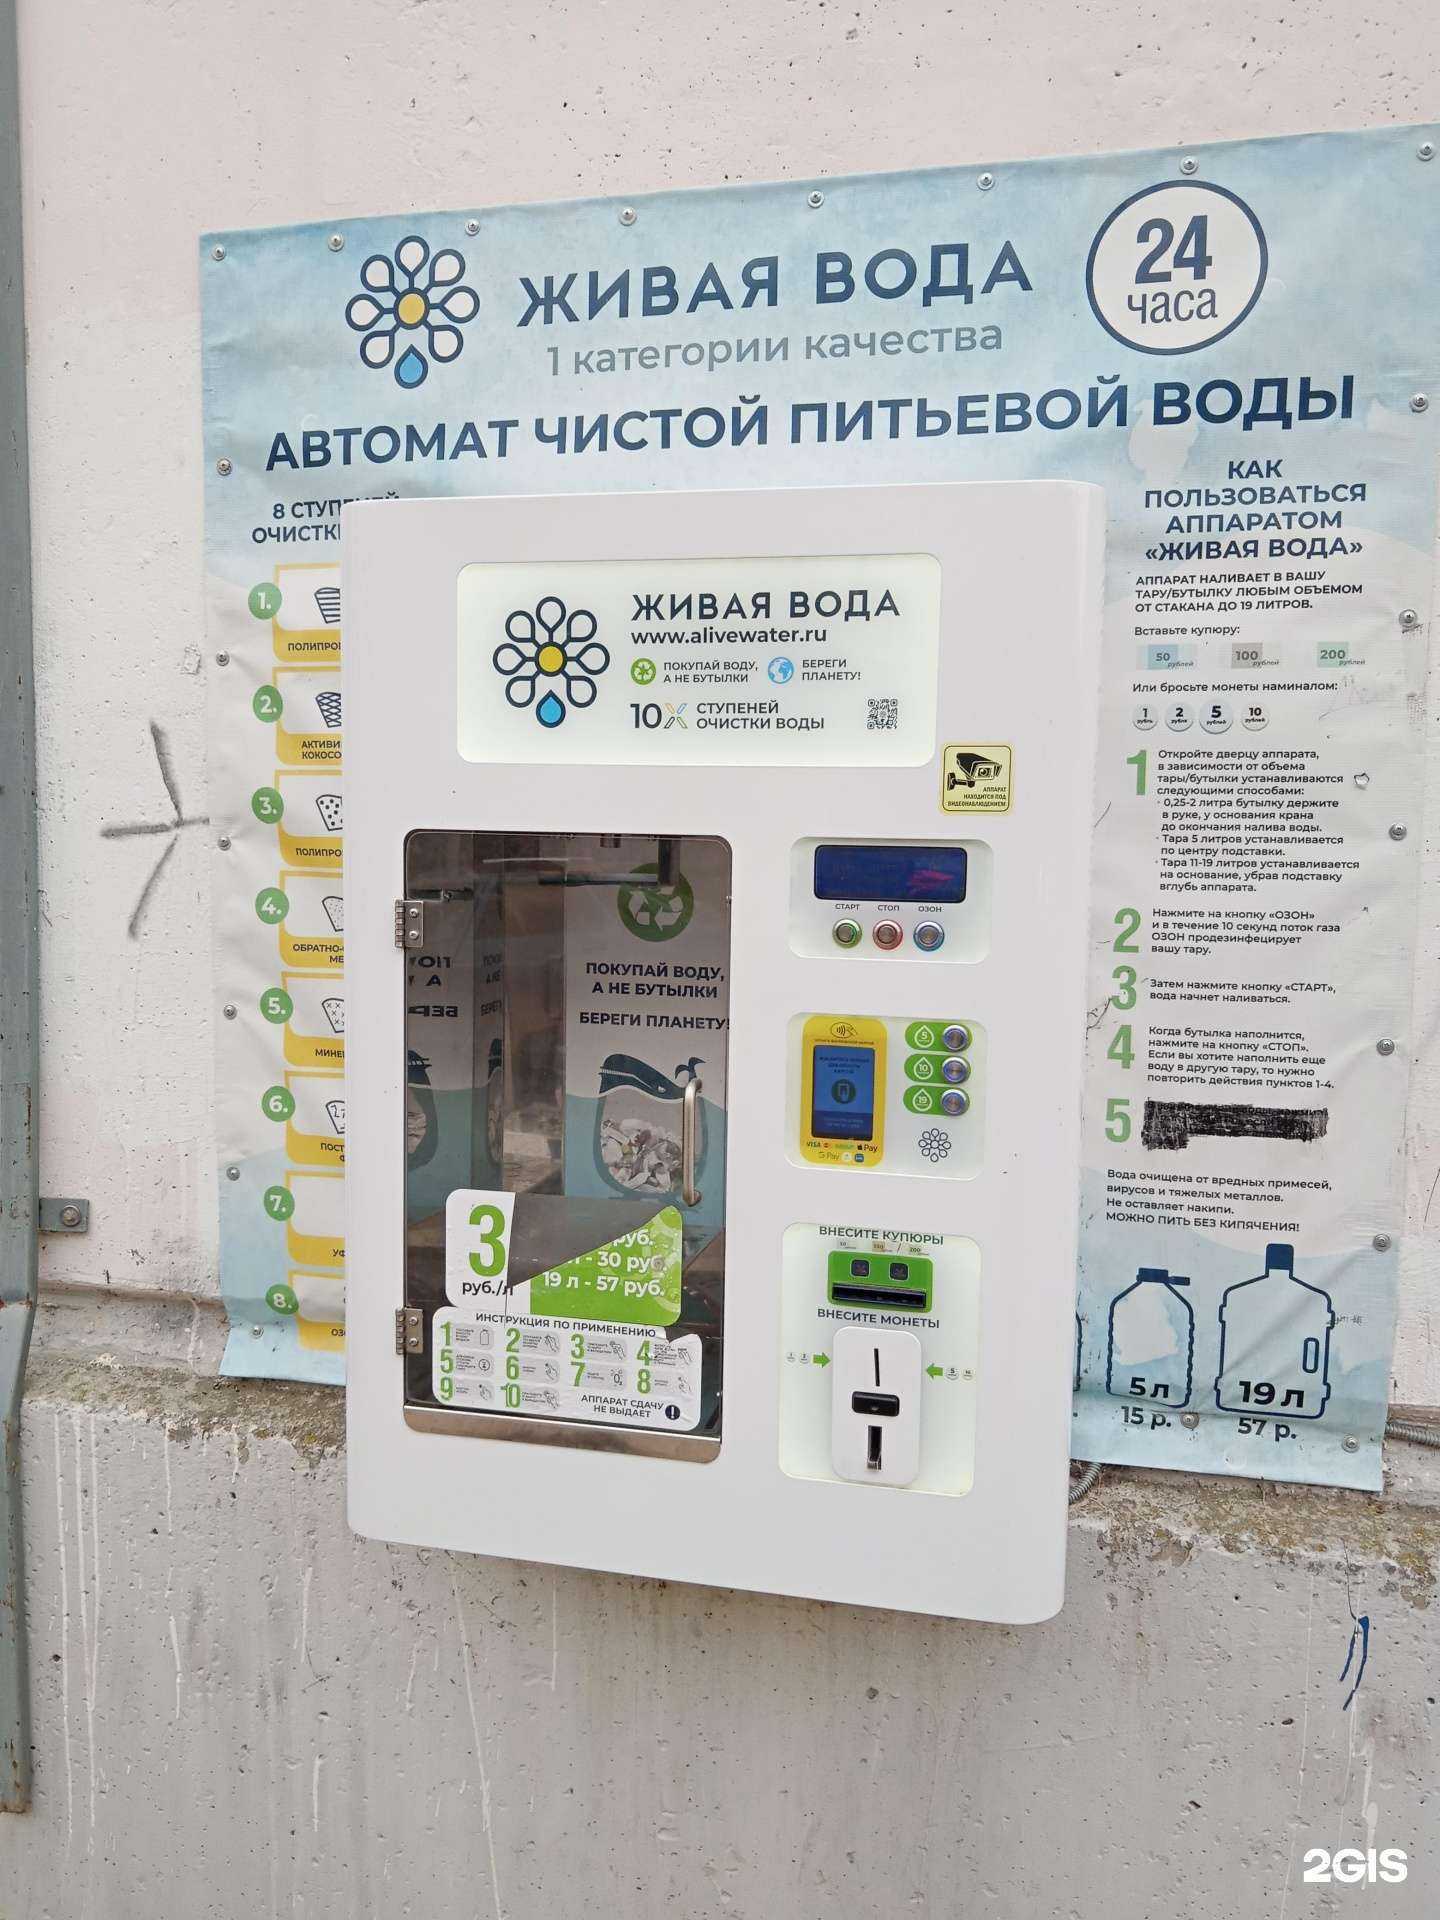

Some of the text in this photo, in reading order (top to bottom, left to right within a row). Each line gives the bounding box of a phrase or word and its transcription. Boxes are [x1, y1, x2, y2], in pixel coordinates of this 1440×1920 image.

[1135, 215, 1212, 284] 24
[517, 241, 1033, 327] ЖИВАЯ ВОДА
[1128, 289, 1218, 324] часа
[547, 325, 1001, 376] 1 категории качества
[265, 374, 1353, 472] АВТОМАТ ЧИСТОЙ ПИТЬЕВОЙ ВОДЫ
[1229, 459, 1283, 479] КАК
[1145, 483, 1366, 508] ПОЛЬЗОВАТЬСЯ
[273, 503, 285, 519] 8
[1165, 511, 1341, 534] АППАРАТОМ
[1146, 538, 1362, 560] «ЖИВАЯ ВОДА»
[1135, 570, 1326, 586] АППАРАТ НАЛИВАЕТ В ВАШУ
[258, 592, 271, 610] 1.
[1135, 584, 1363, 600] ТАРУ/БУТЫЛКУ ЛЮБЫМ ОБЪЕМОМ
[632, 590, 900, 621] ЖИВАЯ ВОДА
[1134, 599, 1313, 613] ОТ СТАКАНА ДО 19 ЛИТРОВ.
[631, 626, 826, 644] www.alivewater.ru
[1134, 626, 1240, 637] Вставьте купюру:
[802, 658, 847, 669] БЕРЕГИ
[1154, 651, 1172, 663] 50
[1235, 649, 1259, 662] 100
[1319, 648, 1347, 661] 200
[663, 659, 758, 672] ПОКУПАЙ ВОДУ,
[663, 673, 749, 683] А НЕ БУТЫЛКИ
[801, 671, 861, 681] ПЛАНЕТУ!
[1132, 681, 1338, 694] Или бросьте монеты наминалом:
[260, 695, 277, 713] 2.
[697, 700, 778, 714] СТУПЕНЕЙ
[1142, 707, 1149, 718] 1
[1174, 706, 1185, 718] 2
[1211, 705, 1222, 718] 5
[1248, 706, 1263, 718] 10
[696, 717, 824, 731] ОЧИСТКИ ВОДЫ
[1158, 749, 1320, 761] Откройте дверцу аппарата,
[1126, 749, 1147, 795] 1
[259, 797, 277, 815] 3.
[261, 897, 282, 915] 4.
[1152, 908, 1315, 922] Нажмите на кнопку «ОЗОН»
[1113, 907, 1142, 953] 2
[585, 962, 725, 981] ПОКУПАЙ ВОДУ,
[592, 982, 718, 998] А НЕ БУТЫЛКИ
[1110, 965, 1138, 1010] 3
[1150, 978, 1336, 994] Затем нажмите кнопку «СТАРТ»,
[268, 997, 286, 1015] 5.
[1149, 992, 1291, 1004] вода начнет наливаться.
[580, 1012, 641, 1027] БЕРЕГИ
[1107, 1024, 1135, 1069] 4
[269, 1095, 288, 1113] 6.
[1104, 1098, 1132, 1143] 5
[805, 1140, 822, 1149] VISA
[863, 1143, 879, 1153] Pay
[1107, 1168, 1332, 1191] Вода очищена от вредных примесей,
[1106, 1184, 1284, 1202] вирусов и тяжелых металлов.
[270, 1195, 286, 1212] 7.
[1106, 1197, 1235, 1215] Не оставляет накипи.
[1106, 1211, 1300, 1232] МОЖНО ПИТЬ БЕЗ КИПЯЧЕНИЯ!
[469, 1204, 506, 1277] 3
[819, 1226, 944, 1245] ВНЕСИТЕ КУПЮРЫ
[597, 1252, 621, 1268] 30
[543, 1271, 665, 1296] 19 л 57 руб.
[273, 1292, 292, 1309] 8.
[475, 1313, 656, 1337] ИНСТРУКЦИЯ ПО ПРИМЕНЕНИЮ
[817, 1308, 940, 1328] ВНЕСИТЕ МОНЕТЫ
[440, 1321, 452, 1346] 1
[505, 1327, 521, 1353] 2
[570, 1333, 585, 1359] 3
[636, 1340, 652, 1367] 4
[440, 1348, 455, 1374] 5
[505, 1356, 520, 1381] 6
[570, 1362, 586, 1387] 7
[637, 1368, 651, 1394] 8
[440, 1377, 455, 1401] 9
[501, 1382, 521, 1409] 10
[1129, 1377, 1169, 1398] 5 л
[1239, 1381, 1304, 1408] 19 л
[581, 1394, 664, 1411] АППАРАТ СДАЧУ
[593, 1405, 651, 1419] НЕ ВЫДАЕТ
[1121, 1406, 1172, 1430] 15 р.
[1238, 1416, 1296, 1442] 57 р.
